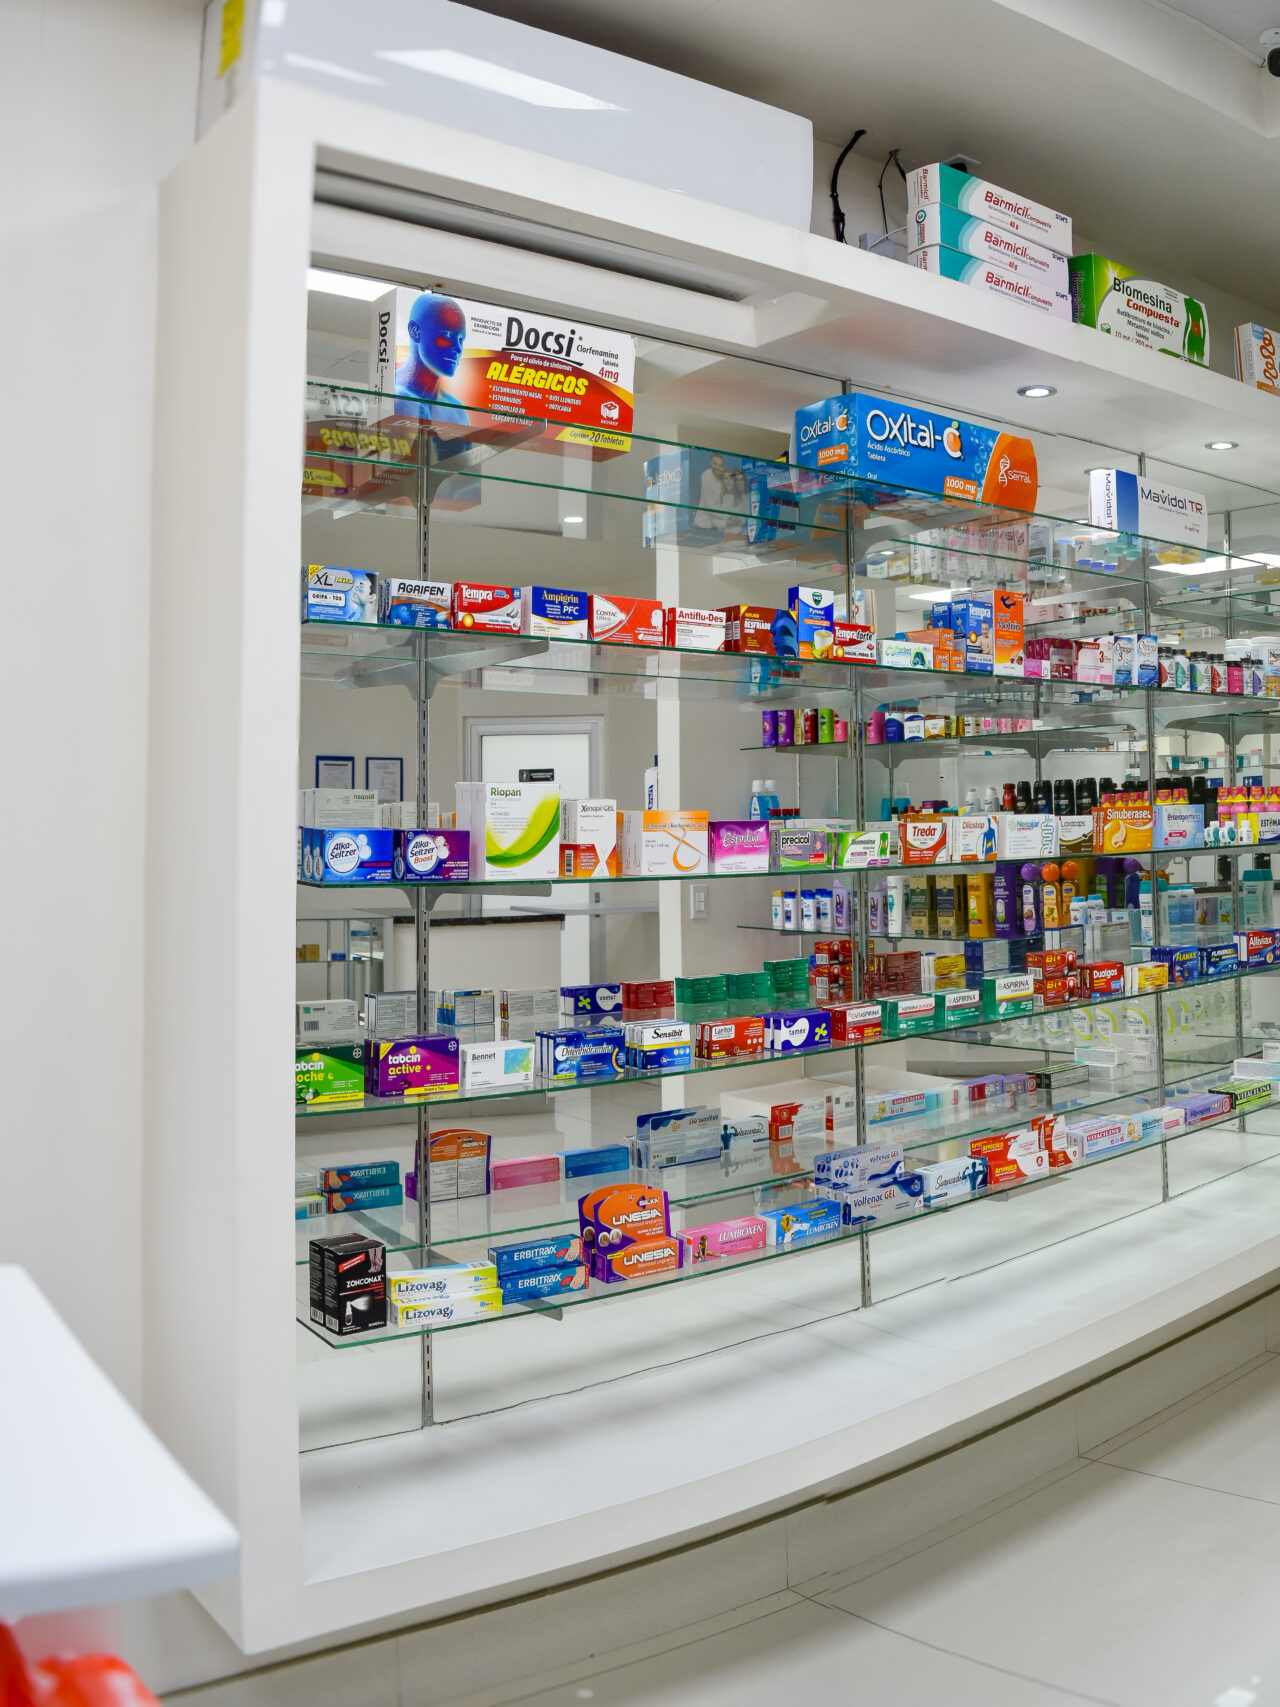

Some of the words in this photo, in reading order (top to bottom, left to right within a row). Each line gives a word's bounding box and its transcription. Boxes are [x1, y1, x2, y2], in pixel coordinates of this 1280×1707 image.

[985, 190, 1028, 219] Barmicil
[984, 230, 1027, 258] Barmicil
[985, 271, 1029, 299] Barmicil
[1113, 276, 1173, 314] Biomesina
[1126, 298, 1180, 328] Compuesta
[378, 311, 391, 364] Docsi
[505, 316, 576, 358] Docsi
[510, 353, 522, 363] Para
[523, 355, 529, 364] el
[576, 344, 619, 360] Clorfenamina
[486, 361, 589, 396] ALÉRGICOS
[598, 366, 619, 384] 4mg
[800, 412, 849, 443] Oxital-C
[866, 409, 964, 460] Oxital-C
[588, 431, 600, 443] 20
[818, 450, 834, 459] 1000
[867, 440, 884, 452] Ácido
[884, 445, 911, 457] Ascórbico
[867, 451, 887, 462] Tableta
[867, 471, 878, 480] Oral
[946, 478, 964, 490] 1000
[964, 482, 977, 494] mg
[1105, 472, 1113, 518] Mavidol
[1140, 486, 1187, 510] Mavidol
[1188, 500, 1203, 515] TR
[397, 582, 445, 596] AGRIFEN
[460, 584, 493, 604] Tempra
[541, 590, 579, 605] Ampigrin
[562, 605, 580, 615] PFC
[595, 609, 618, 618] CONTAC
[678, 611, 724, 623] Antiflu-Des
[968, 603, 992, 620] Tempra
[834, 626, 857, 642] Tempra
[855, 630, 873, 644] forte
[490, 787, 522, 798] Riopan
[1106, 808, 1149, 820] Sinuberase
[912, 825, 937, 838] Treda
[961, 821, 985, 830] Dilostop
[332, 842, 353, 852] Alka-
[412, 840, 432, 850] Alka-
[781, 832, 811, 849] precicol
[330, 849, 357, 860] Seltzer
[409, 847, 435, 858] Seltzer
[413, 854, 434, 864] Boost
[1175, 951, 1197, 962] FLANAX
[1092, 968, 1118, 980] Dualgos
[1002, 979, 1030, 991] ASPIRINA
[952, 993, 977, 1004] ASPIRINA
[851, 1009, 880, 1020] CAFIASPIRINA
[651, 1028, 684, 1040] Sensibit
[714, 1026, 733, 1036] Laritol
[471, 1052, 496, 1062] Bennet
[561, 1043, 613, 1057] Difenhidramina
[388, 1053, 421, 1066] tabcin
[388, 1064, 421, 1077] active
[1236, 1083, 1271, 1100] VITACILINA
[1086, 1127, 1121, 1142] VITACILINA
[869, 1153, 891, 1163] Volfenac
[890, 1150, 899, 1160] GEL
[853, 1192, 883, 1208] Volfenac
[884, 1189, 896, 1200] GEL
[612, 1207, 663, 1226] UNESIA
[718, 1223, 764, 1243] LUMBOXEN
[806, 1220, 840, 1236] LUMBOXEN
[513, 1244, 557, 1262] ERBITRAX
[623, 1246, 676, 1267] UNESIA
[346, 1274, 383, 1289] ZONCONAX
[397, 1279, 447, 1294] Lizovag
[517, 1272, 562, 1290] ERBITRAX
[405, 1304, 454, 1321] Lizovag
